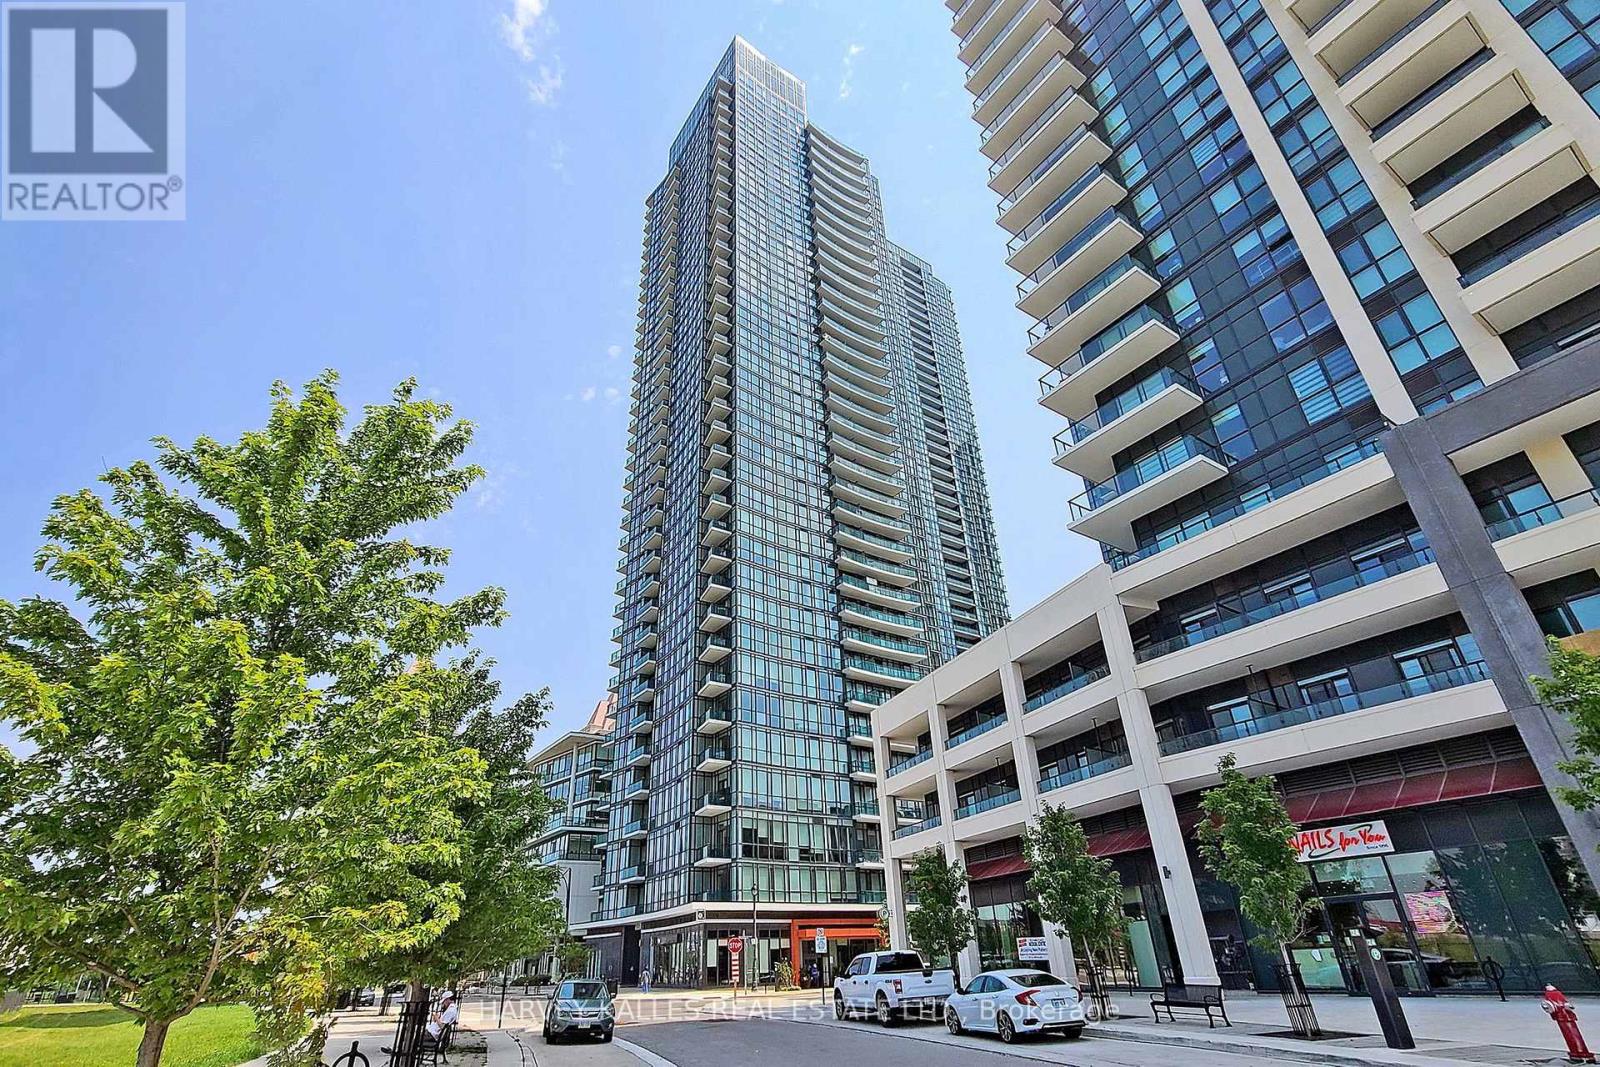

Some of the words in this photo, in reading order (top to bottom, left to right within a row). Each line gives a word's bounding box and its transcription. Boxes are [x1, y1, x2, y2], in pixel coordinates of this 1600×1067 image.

[1287, 829, 1335, 856] NAILS
[1339, 831, 1360, 852] for
[1358, 828, 1386, 846] You
[729, 941, 742, 950] STOP
